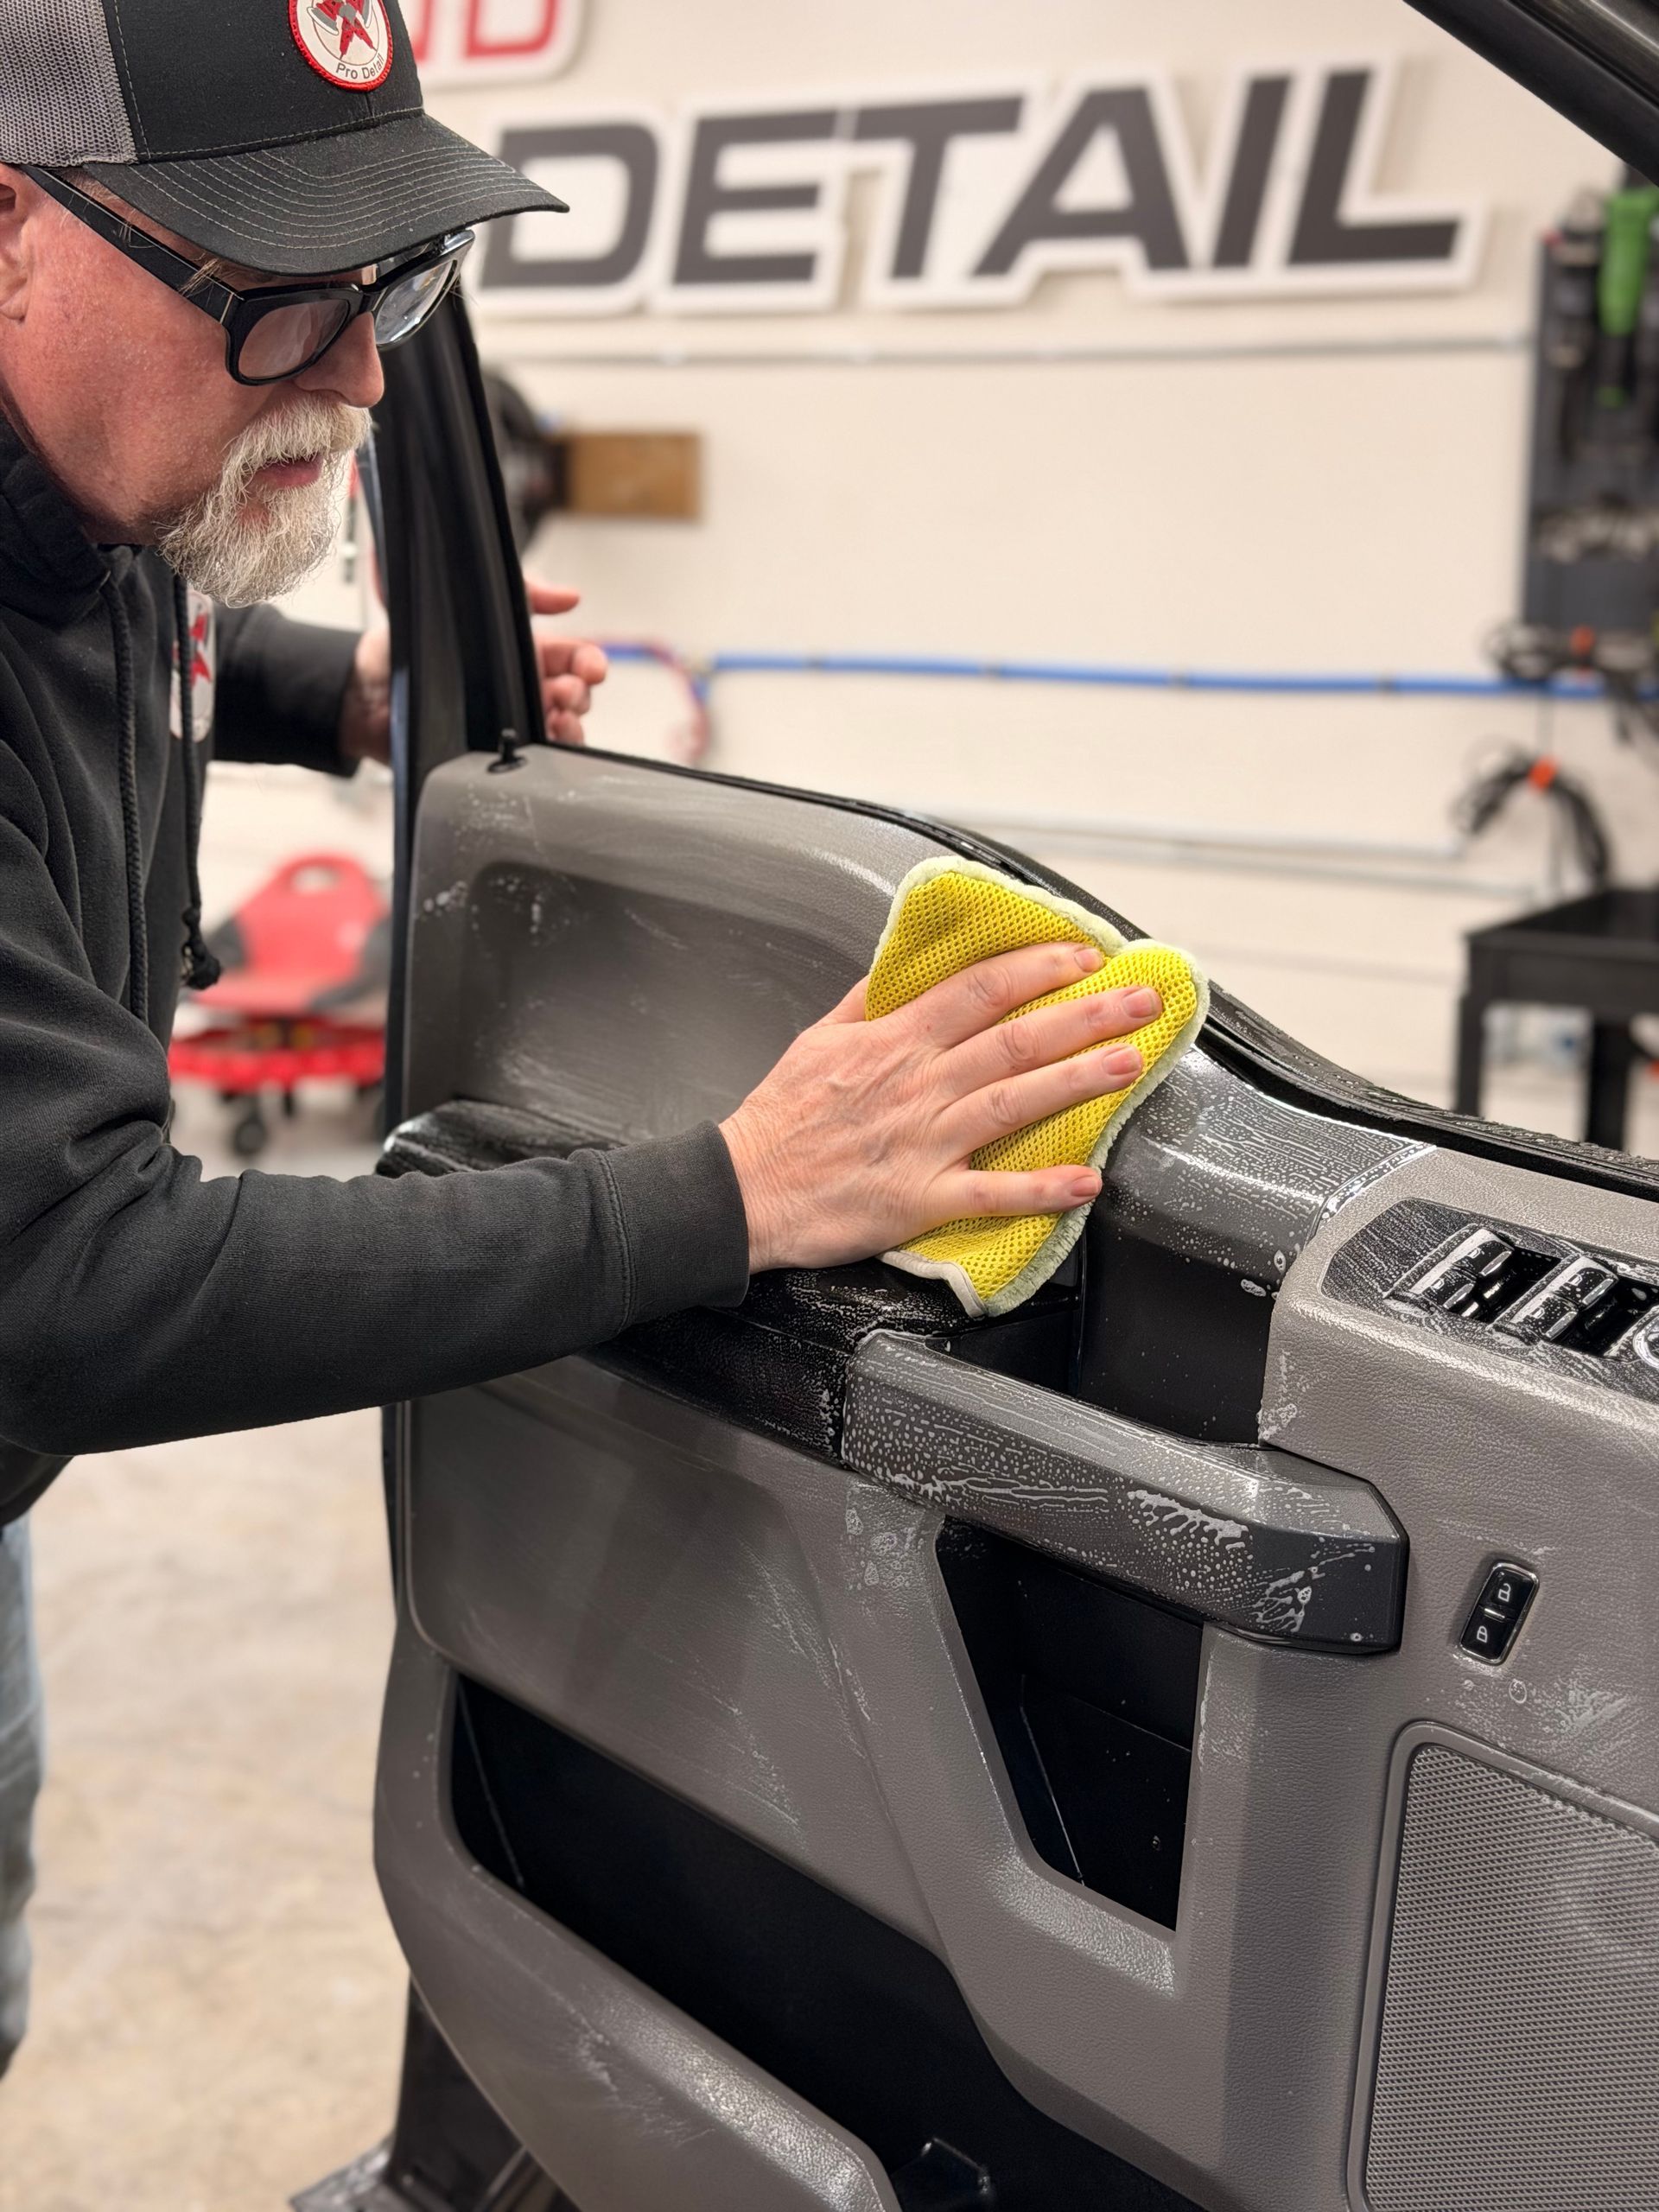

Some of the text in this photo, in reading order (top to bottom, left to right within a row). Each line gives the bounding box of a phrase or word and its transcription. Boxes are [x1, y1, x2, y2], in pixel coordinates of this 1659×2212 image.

[336, 53, 385, 79] Pro Detail
[479, 69, 1461, 288] DETAIL
